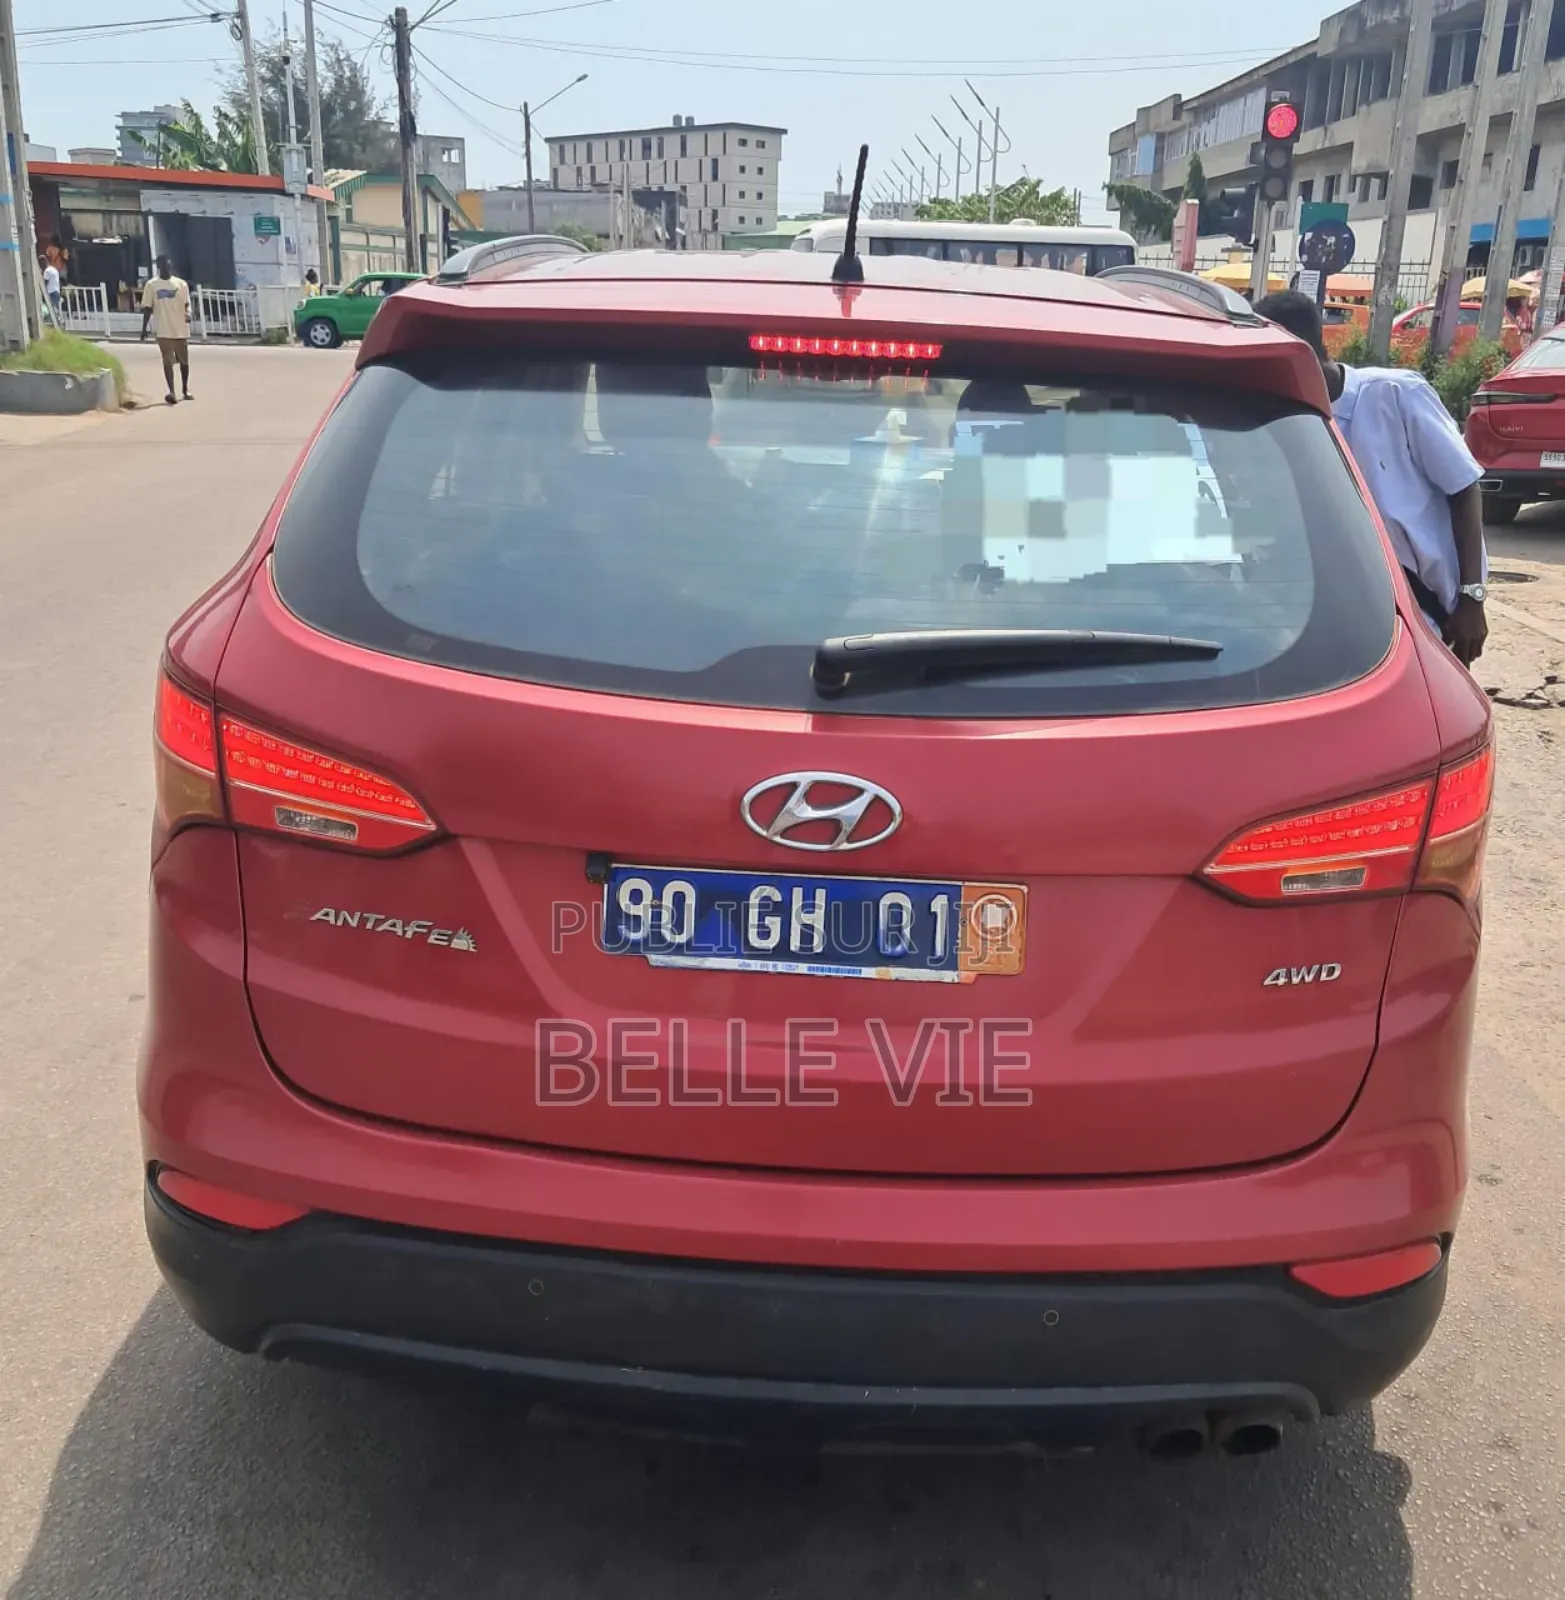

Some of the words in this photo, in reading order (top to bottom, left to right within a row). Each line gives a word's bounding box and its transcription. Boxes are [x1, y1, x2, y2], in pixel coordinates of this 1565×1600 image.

[308, 907, 453, 946] ANTAFE
[617, 878, 696, 943] 90
[748, 885, 826, 953] GH
[877, 891, 949, 957] 01
[1263, 963, 1342, 986] 4WD
